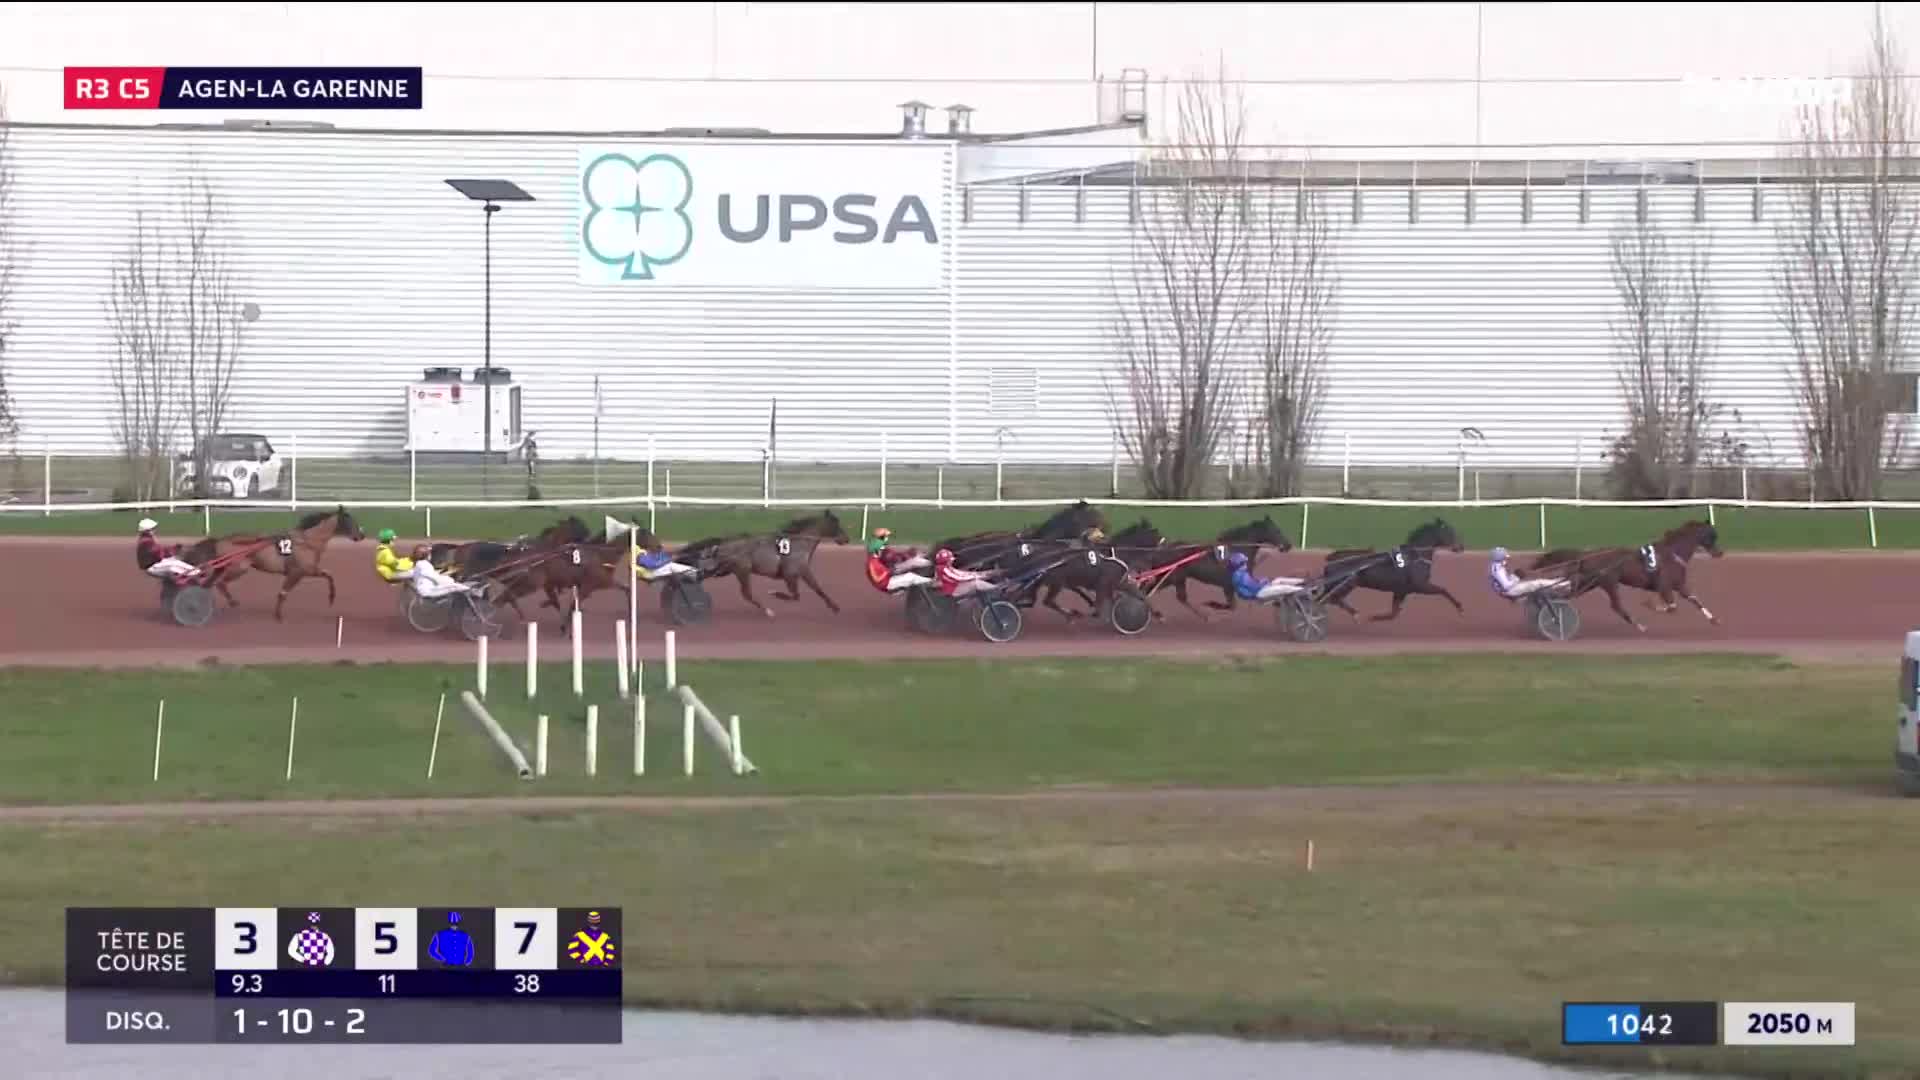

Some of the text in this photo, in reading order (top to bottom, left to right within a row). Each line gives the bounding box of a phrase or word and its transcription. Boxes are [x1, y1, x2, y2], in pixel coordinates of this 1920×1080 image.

[718, 193, 939, 244] UPSA
[278, 539, 293, 554] 12
[778, 538, 791, 555] 13
[1216, 544, 1225, 560] 7
[572, 549, 581, 564] 8
[1087, 550, 1097, 565] 9
